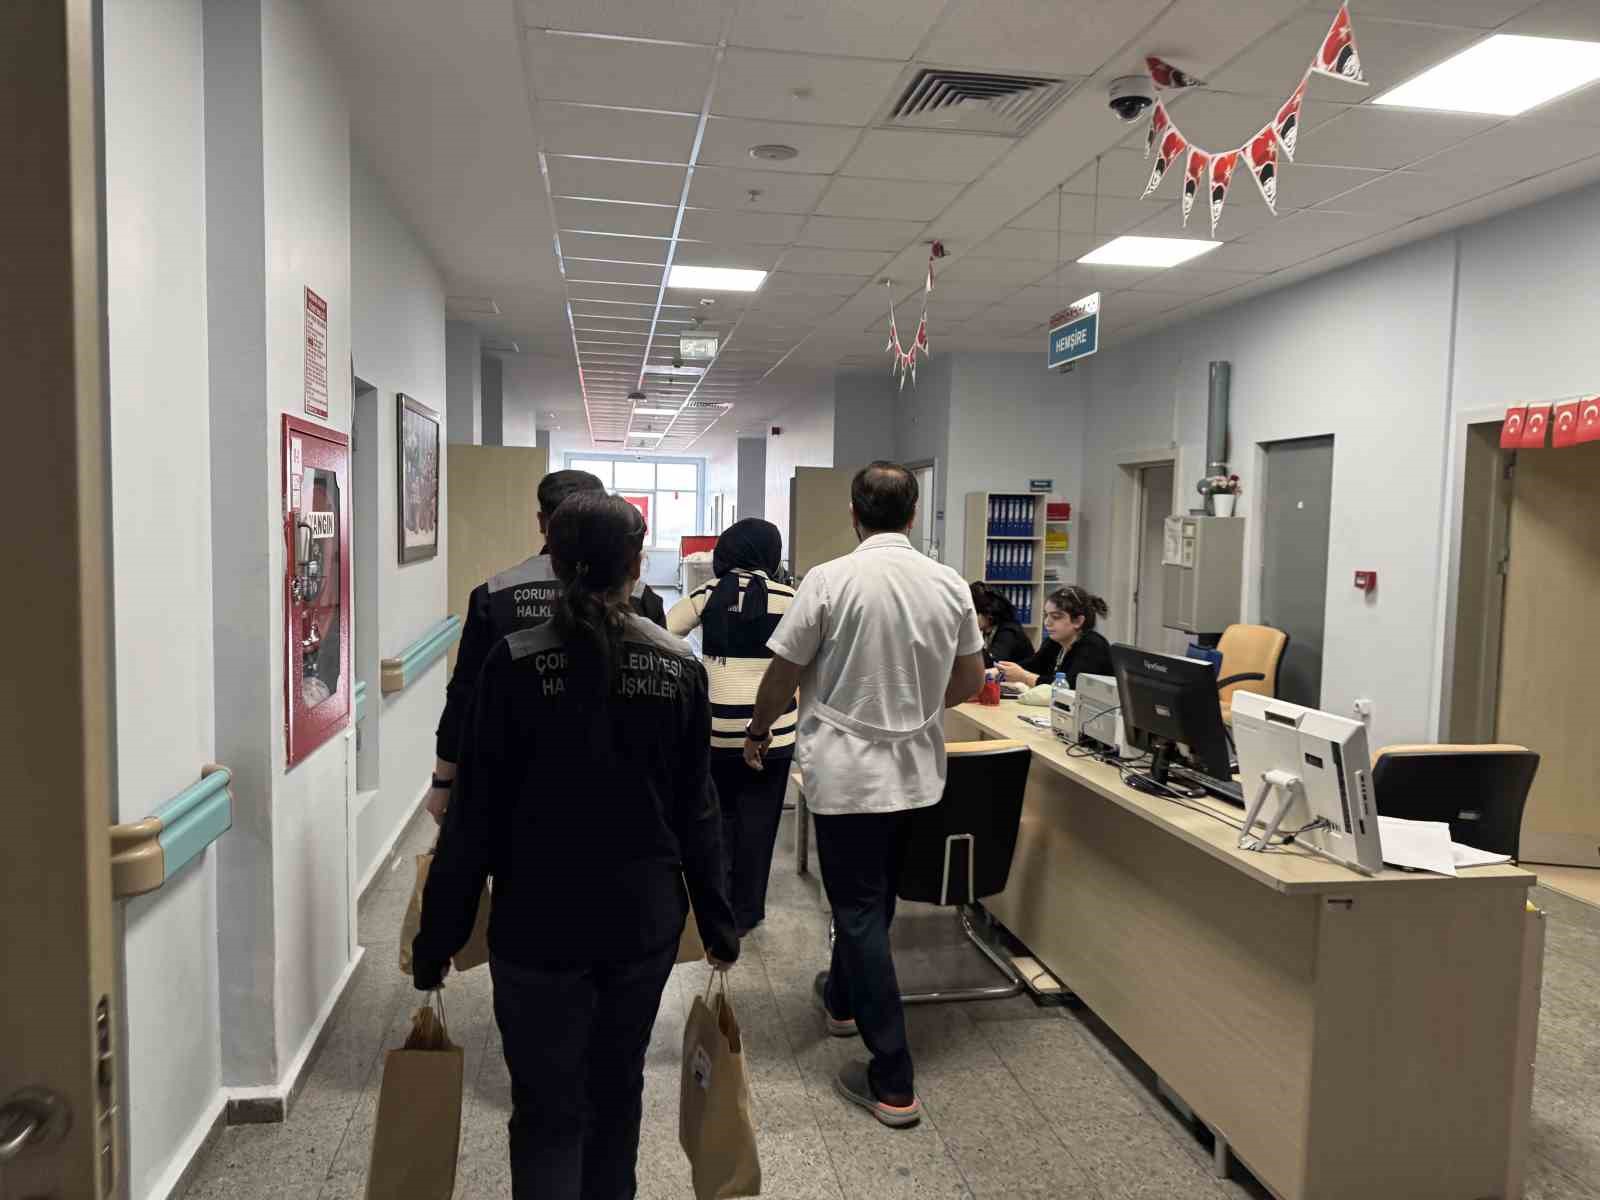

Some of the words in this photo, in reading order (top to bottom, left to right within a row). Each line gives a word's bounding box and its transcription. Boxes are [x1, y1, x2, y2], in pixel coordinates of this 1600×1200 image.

[1056, 328, 1087, 352] HEMŞİRE
[308, 513, 332, 535] YANGIN
[513, 588, 555, 603] ÇORUM
[516, 605, 554, 617] HALKL
[535, 653, 569, 675] ÇOR
[617, 672, 679, 700] İŞKİLER
